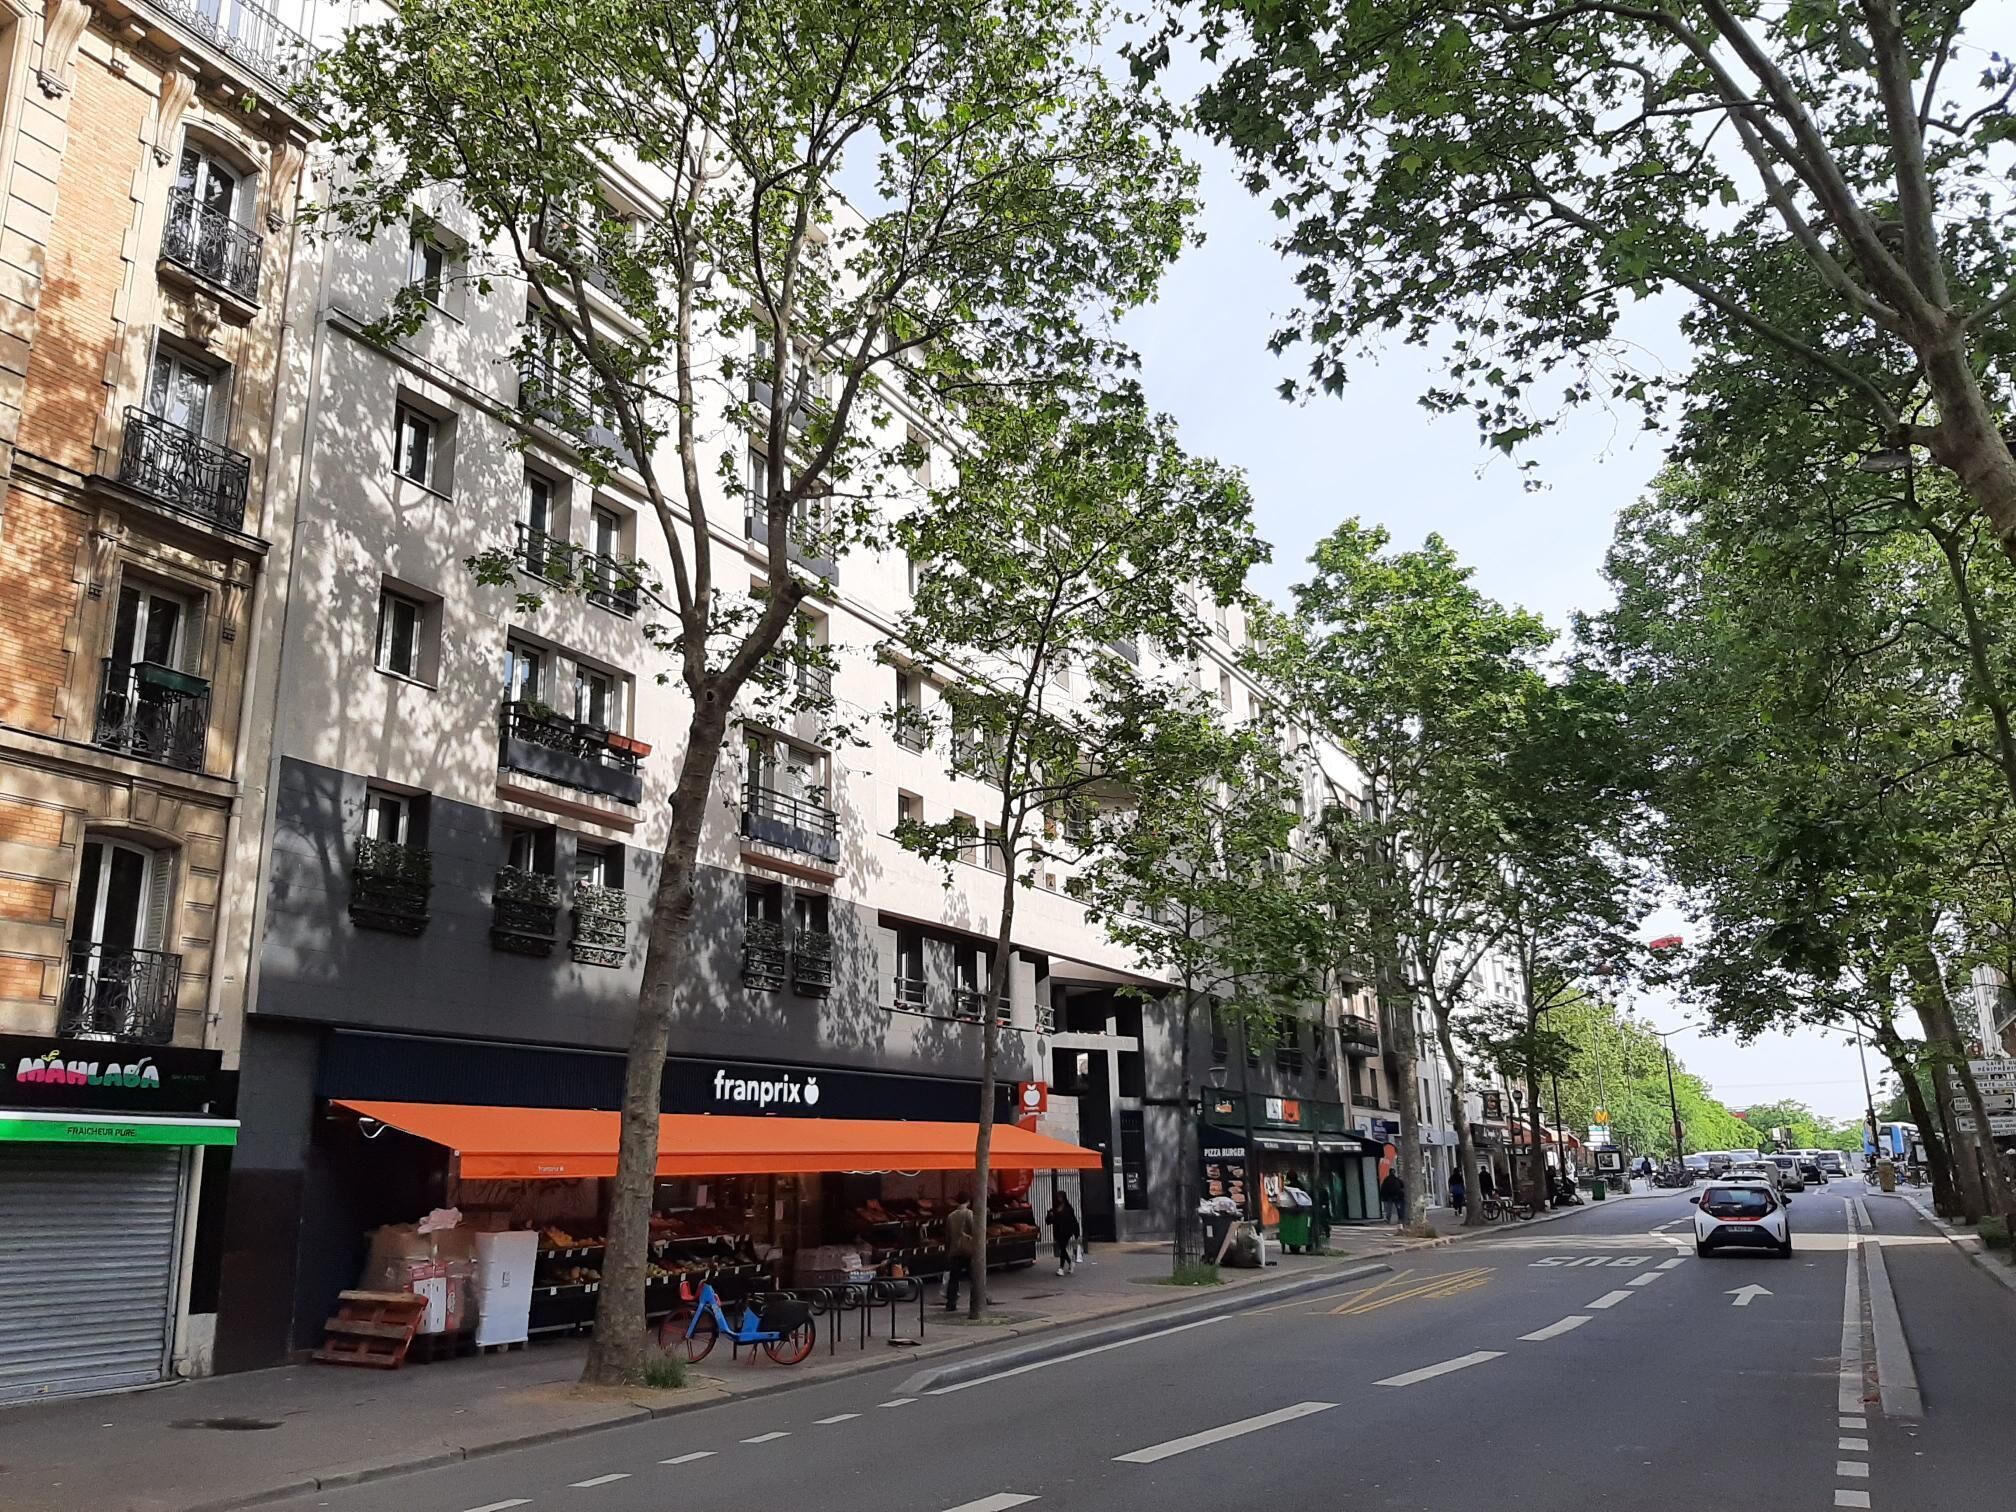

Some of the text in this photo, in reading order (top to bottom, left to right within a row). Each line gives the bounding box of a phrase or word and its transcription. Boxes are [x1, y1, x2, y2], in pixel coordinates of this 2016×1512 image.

[17, 1057, 160, 1088] MAHLABA
[714, 1070, 801, 1108] franprix
[1595, 1110, 1608, 1122] M
[67, 1126, 137, 1137] FRAICHEUR PURE
[1204, 1148, 1245, 1157] PIZZA BURGER
[1528, 1256, 1653, 1267] BUS
